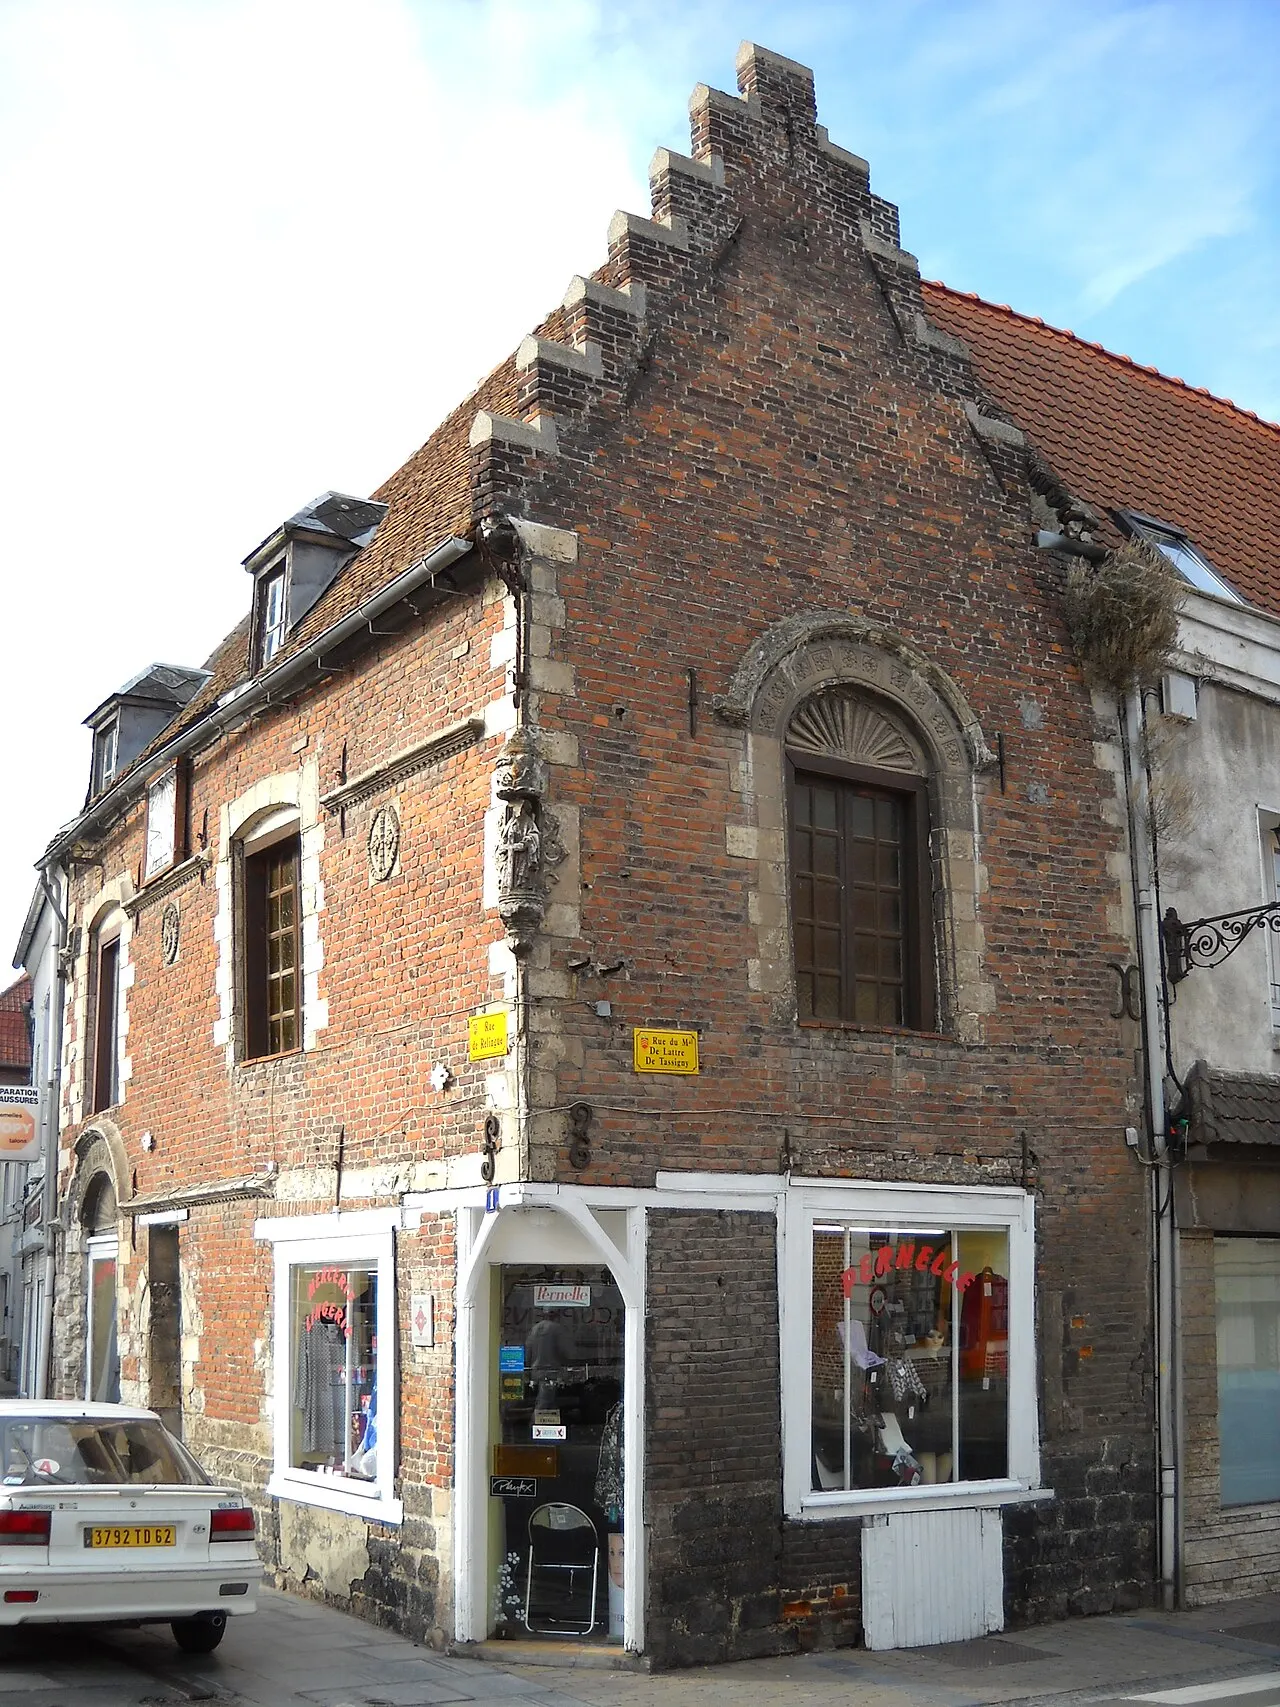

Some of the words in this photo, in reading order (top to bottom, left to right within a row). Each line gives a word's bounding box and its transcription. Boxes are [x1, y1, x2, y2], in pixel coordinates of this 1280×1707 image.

[484, 1020, 495, 1032] Rue
[652, 1036, 667, 1046] Rue
[669, 1037, 679, 1047] du
[649, 1046, 660, 1055] De
[663, 1047, 685, 1057] Lattre
[645, 1056, 656, 1065] De
[659, 1056, 689, 1069] Tassigny
[843, 1243, 976, 1299] PERNELLE
[307, 1264, 356, 1302] MERCERIE
[537, 1286, 589, 1301] Pernelle
[305, 1301, 353, 1338] LINGERIE
[95, 1529, 130, 1545] 3792
[134, 1529, 151, 1545] TD
[155, 1528, 172, 1544] 62
